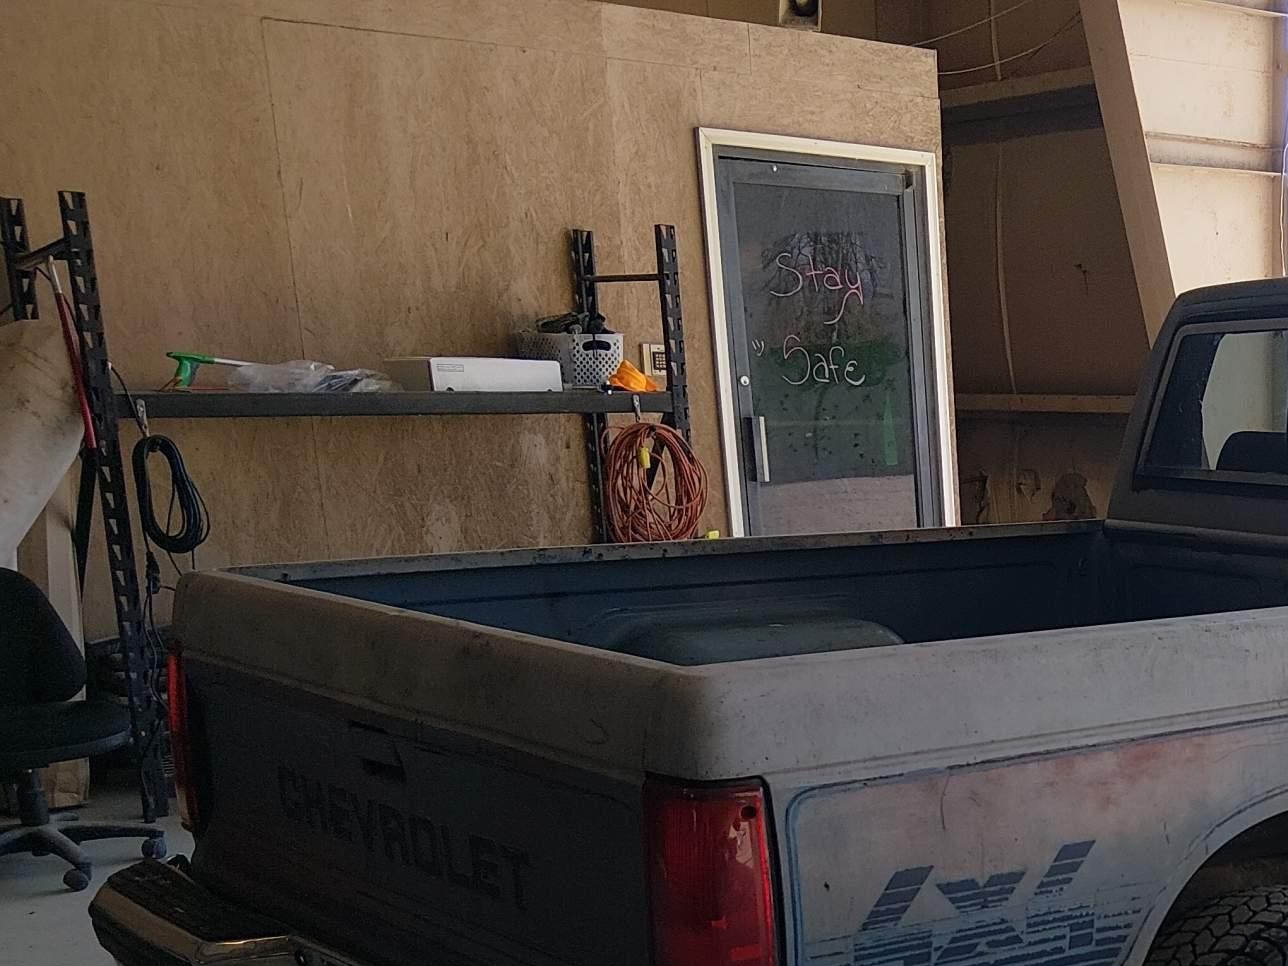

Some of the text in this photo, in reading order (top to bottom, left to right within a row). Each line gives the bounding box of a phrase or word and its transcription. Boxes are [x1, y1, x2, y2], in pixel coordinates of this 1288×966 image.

[770, 253, 864, 324] Stay
[782, 334, 866, 386] Safe
[278, 765, 531, 911] CHEVROLET
